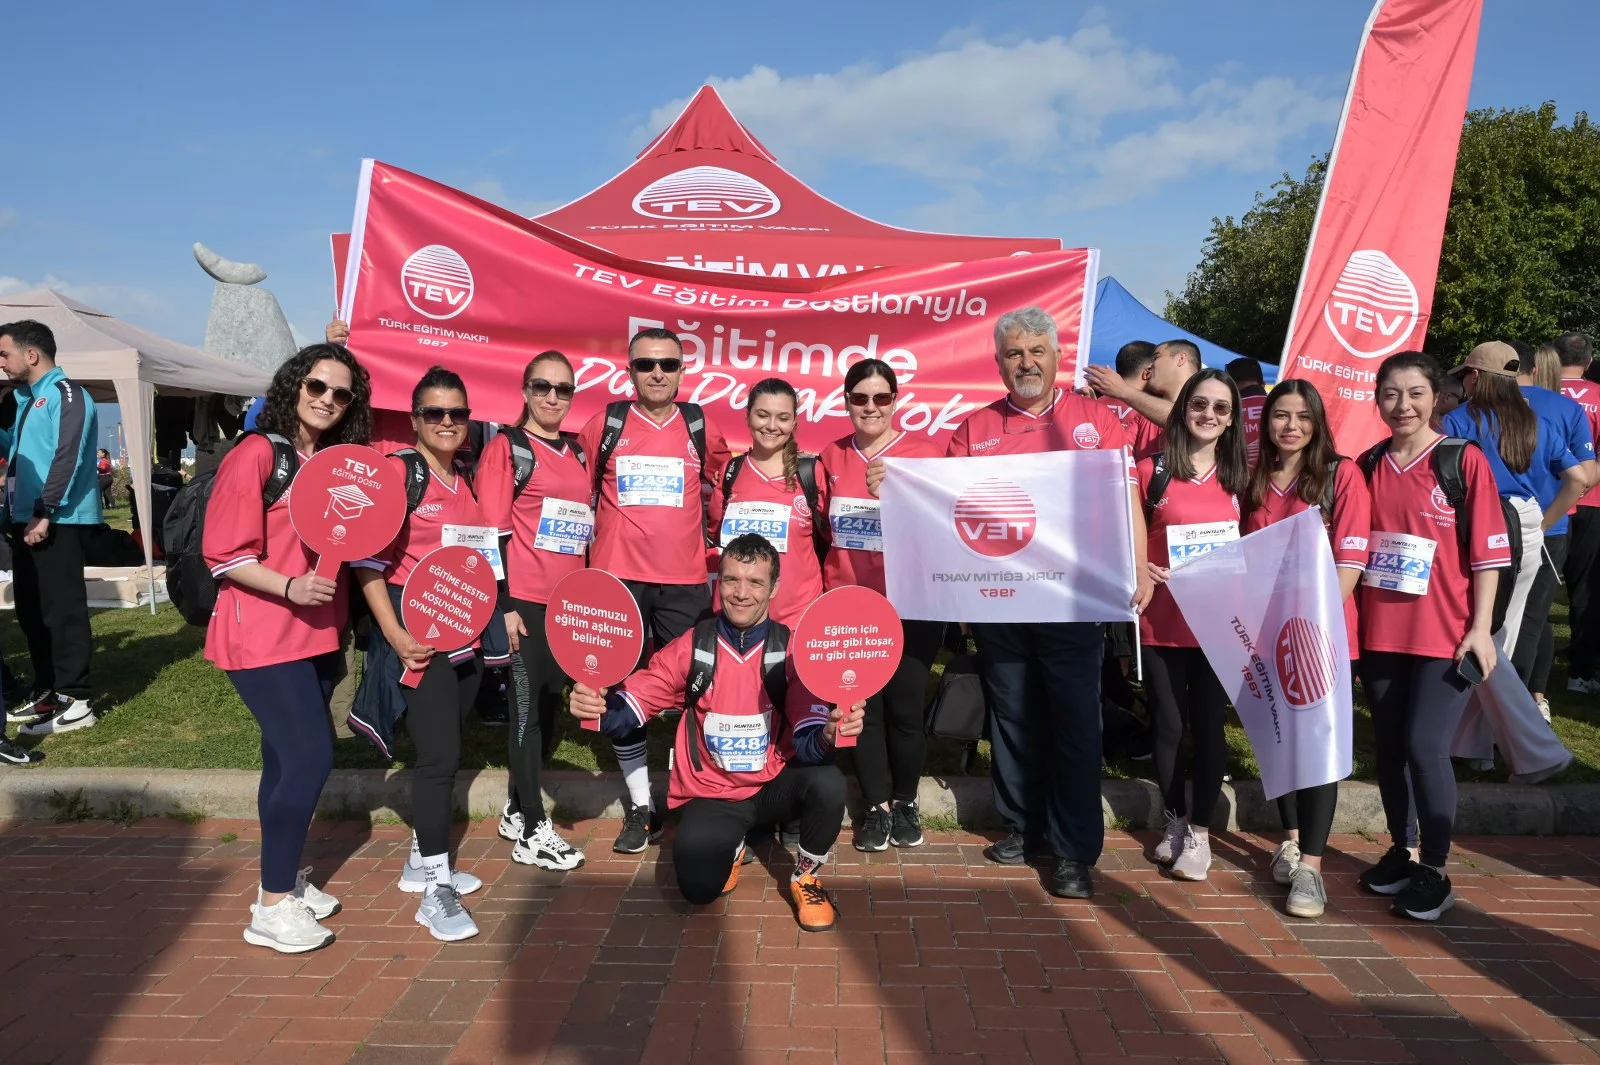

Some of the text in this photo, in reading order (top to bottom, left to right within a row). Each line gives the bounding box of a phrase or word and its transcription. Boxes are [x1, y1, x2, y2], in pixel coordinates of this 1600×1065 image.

[650, 200, 765, 213] TEV
[408, 280, 466, 306] TEV
[573, 263, 988, 323] TEV Eğitim Dostlarıyla
[1333, 301, 1405, 336] TEV
[378, 317, 490, 344] TÜRK EĞİTİM VAKFI
[417, 338, 449, 348] 1967
[688, 372, 850, 423] Duak
[1338, 386, 1375, 401] 1967
[971, 437, 1001, 451] TRENDY
[344, 457, 378, 478] TEV
[331, 467, 382, 490] EĞİTİM DOSTU
[622, 475, 680, 488] 12494
[414, 503, 443, 515] RENDY
[546, 519, 590, 537] 12489
[728, 519, 783, 533] 12485
[1370, 552, 1425, 573] 12473
[428, 564, 460, 587] EĞİTİME
[460, 582, 490, 604] DESTEK
[434, 580, 473, 609] İÇİN NASIL
[422, 590, 472, 623] KOŞUYORUM,
[561, 600, 628, 622] Tempomuzu
[409, 599, 474, 637] OYNAT BAKALIM!
[555, 614, 634, 638] eğitim aşkımız
[572, 630, 613, 649] belirler.
[824, 624, 879, 636] Eğitim için
[806, 637, 894, 649] rüzgar gibi koşar,
[809, 649, 890, 661] arı gibi çalışırız.
[1230, 616, 1256, 653] TÜRK
[1250, 653, 1275, 702] EĞİTİM
[1281, 628, 1301, 700] TEV
[1241, 665, 1262, 700] 1967
[718, 722, 730, 732] 20
[710, 735, 768, 750] 12484
